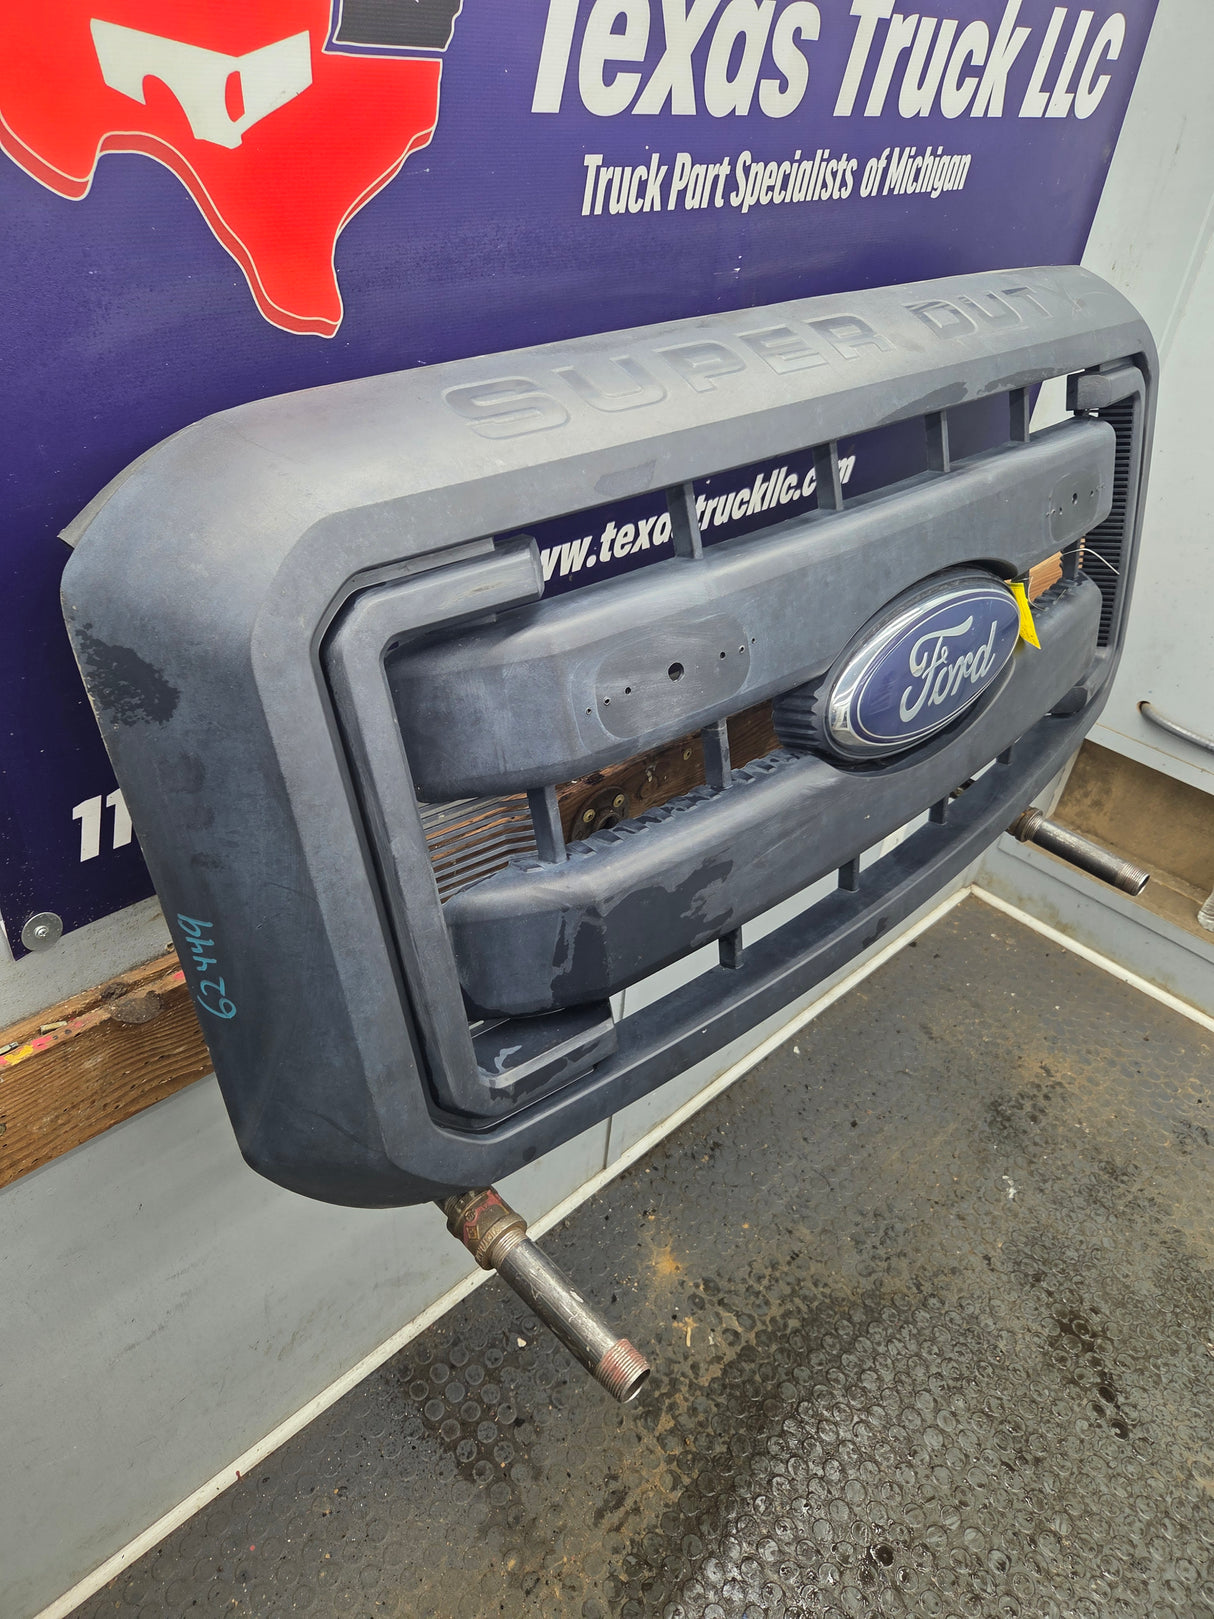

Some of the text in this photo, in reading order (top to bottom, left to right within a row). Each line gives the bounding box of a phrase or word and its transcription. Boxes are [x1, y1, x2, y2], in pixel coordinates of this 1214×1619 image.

[530, 0, 1126, 119] Texas Truck LLC
[581, 146, 972, 216] Truck Part Specialists of Michigan
[441, 311, 898, 441] SUPER
[899, 615, 999, 723] Ford
